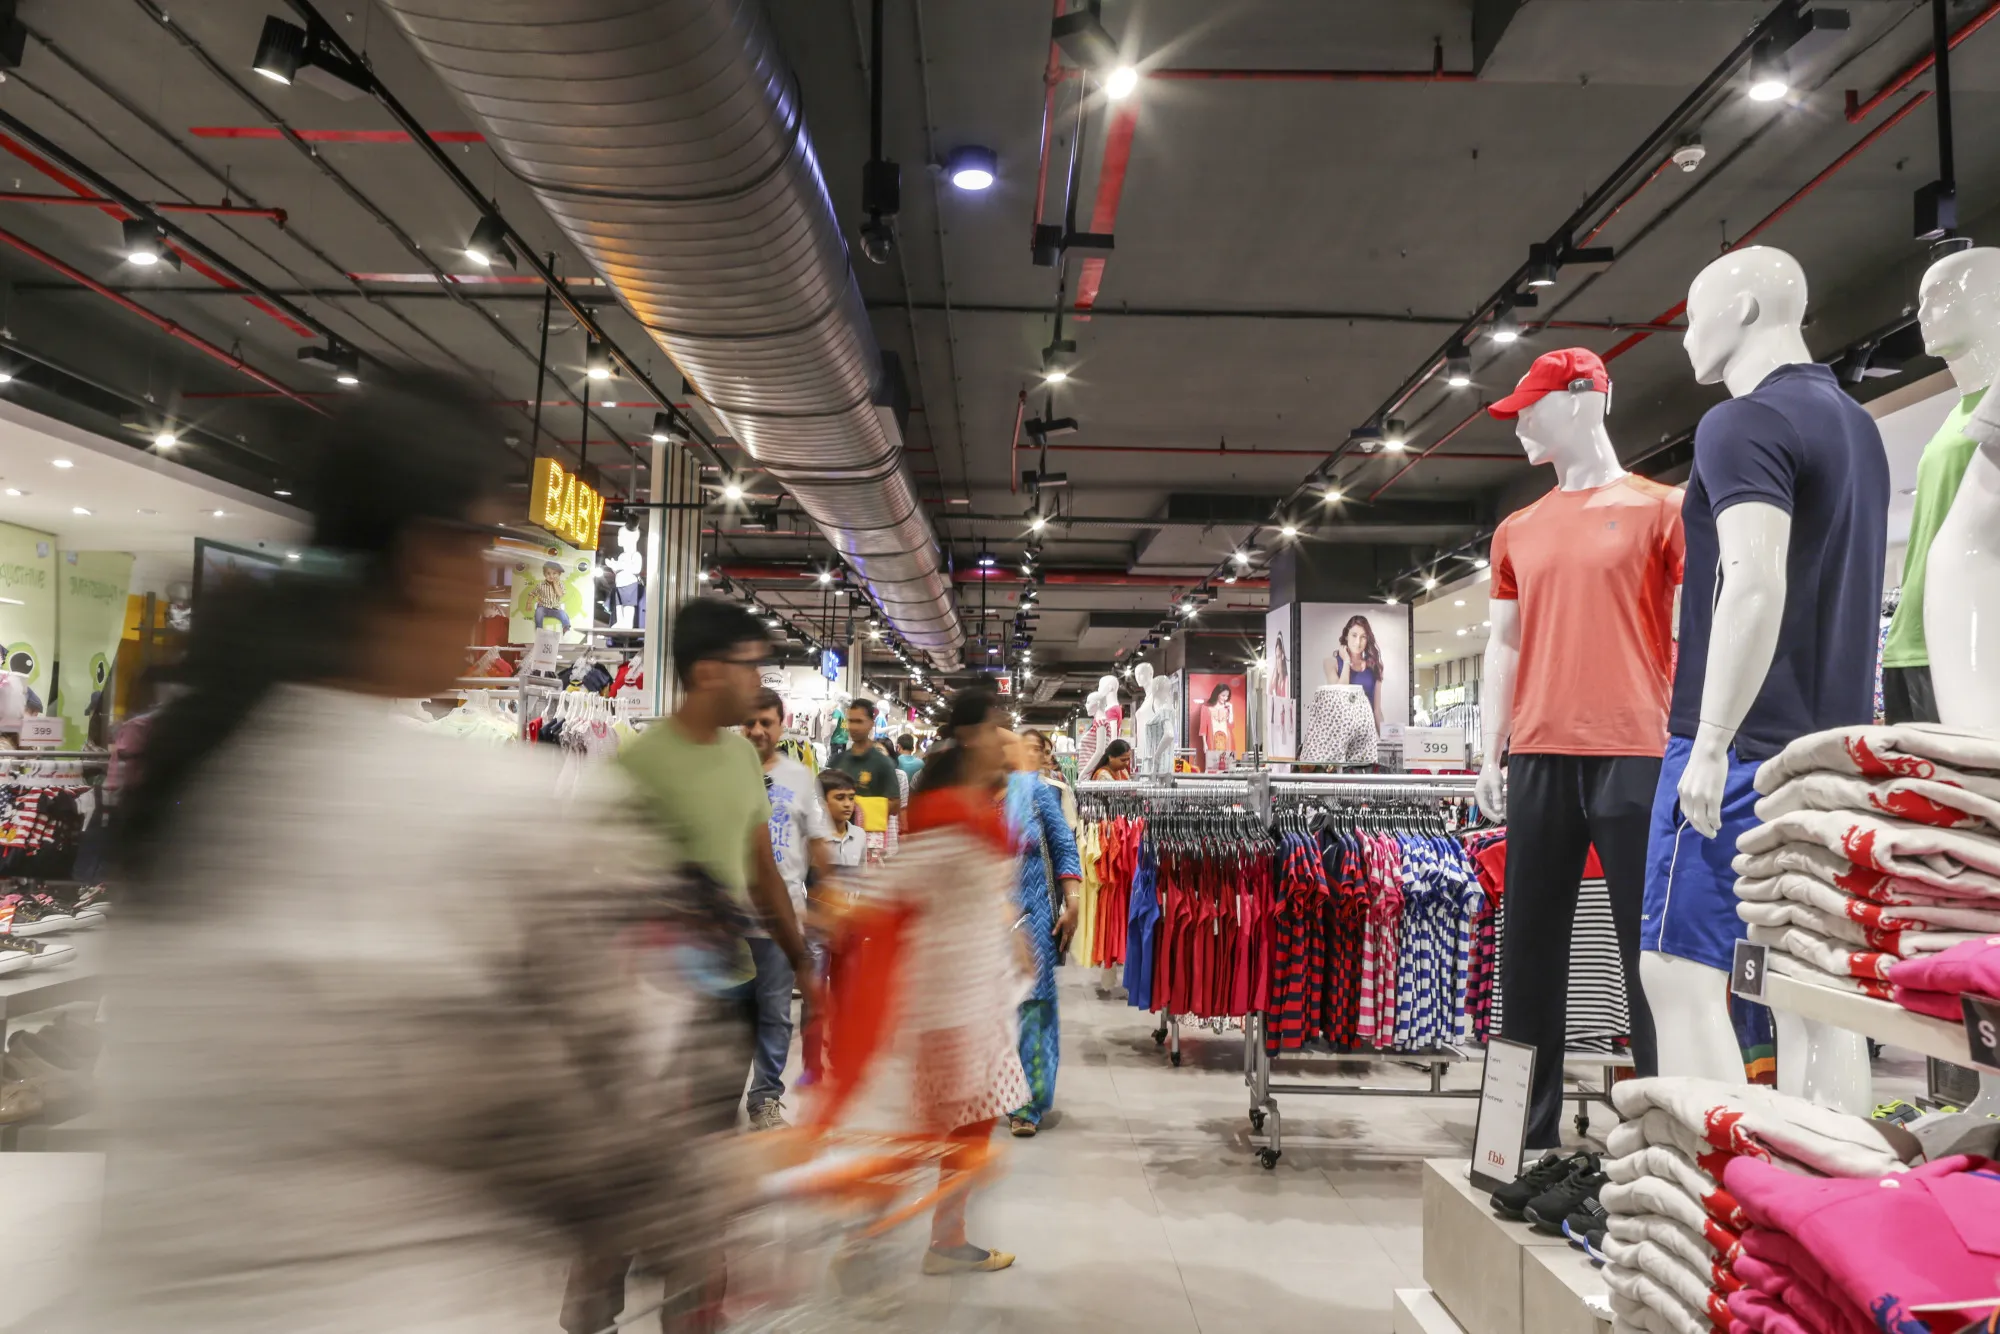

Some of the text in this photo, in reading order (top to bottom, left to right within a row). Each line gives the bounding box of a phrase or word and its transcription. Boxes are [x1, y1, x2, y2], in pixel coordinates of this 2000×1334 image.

[545, 461, 604, 549] BABY
[34, 727, 52, 736] 399
[1423, 742, 1448, 753] 399
[1745, 959, 1755, 980] S
[1978, 1020, 1997, 1048] S
[1488, 1149, 1505, 1166] fbb
